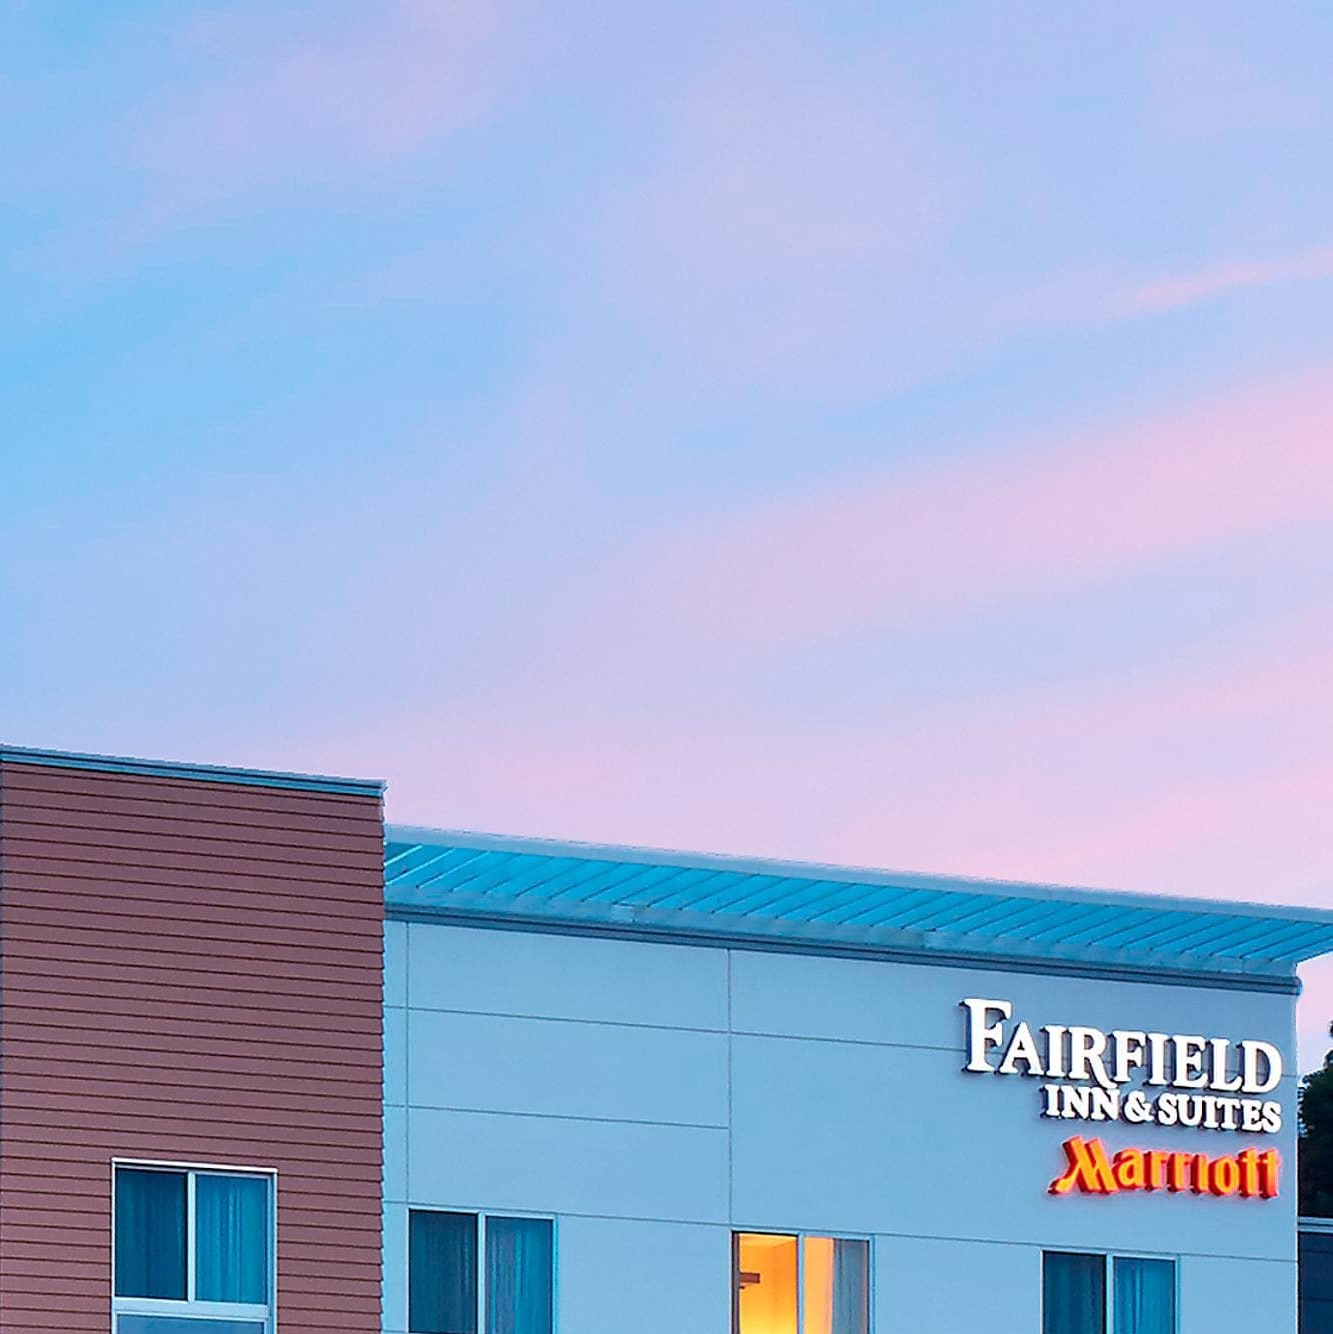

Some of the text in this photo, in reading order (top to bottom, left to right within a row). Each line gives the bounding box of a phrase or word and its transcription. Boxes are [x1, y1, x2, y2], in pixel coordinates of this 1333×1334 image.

[960, 998, 1283, 1094] FAIRFIELD
[1040, 1084, 1282, 1133] INN & SUITES
[1048, 1135, 1280, 1198] Marriott
